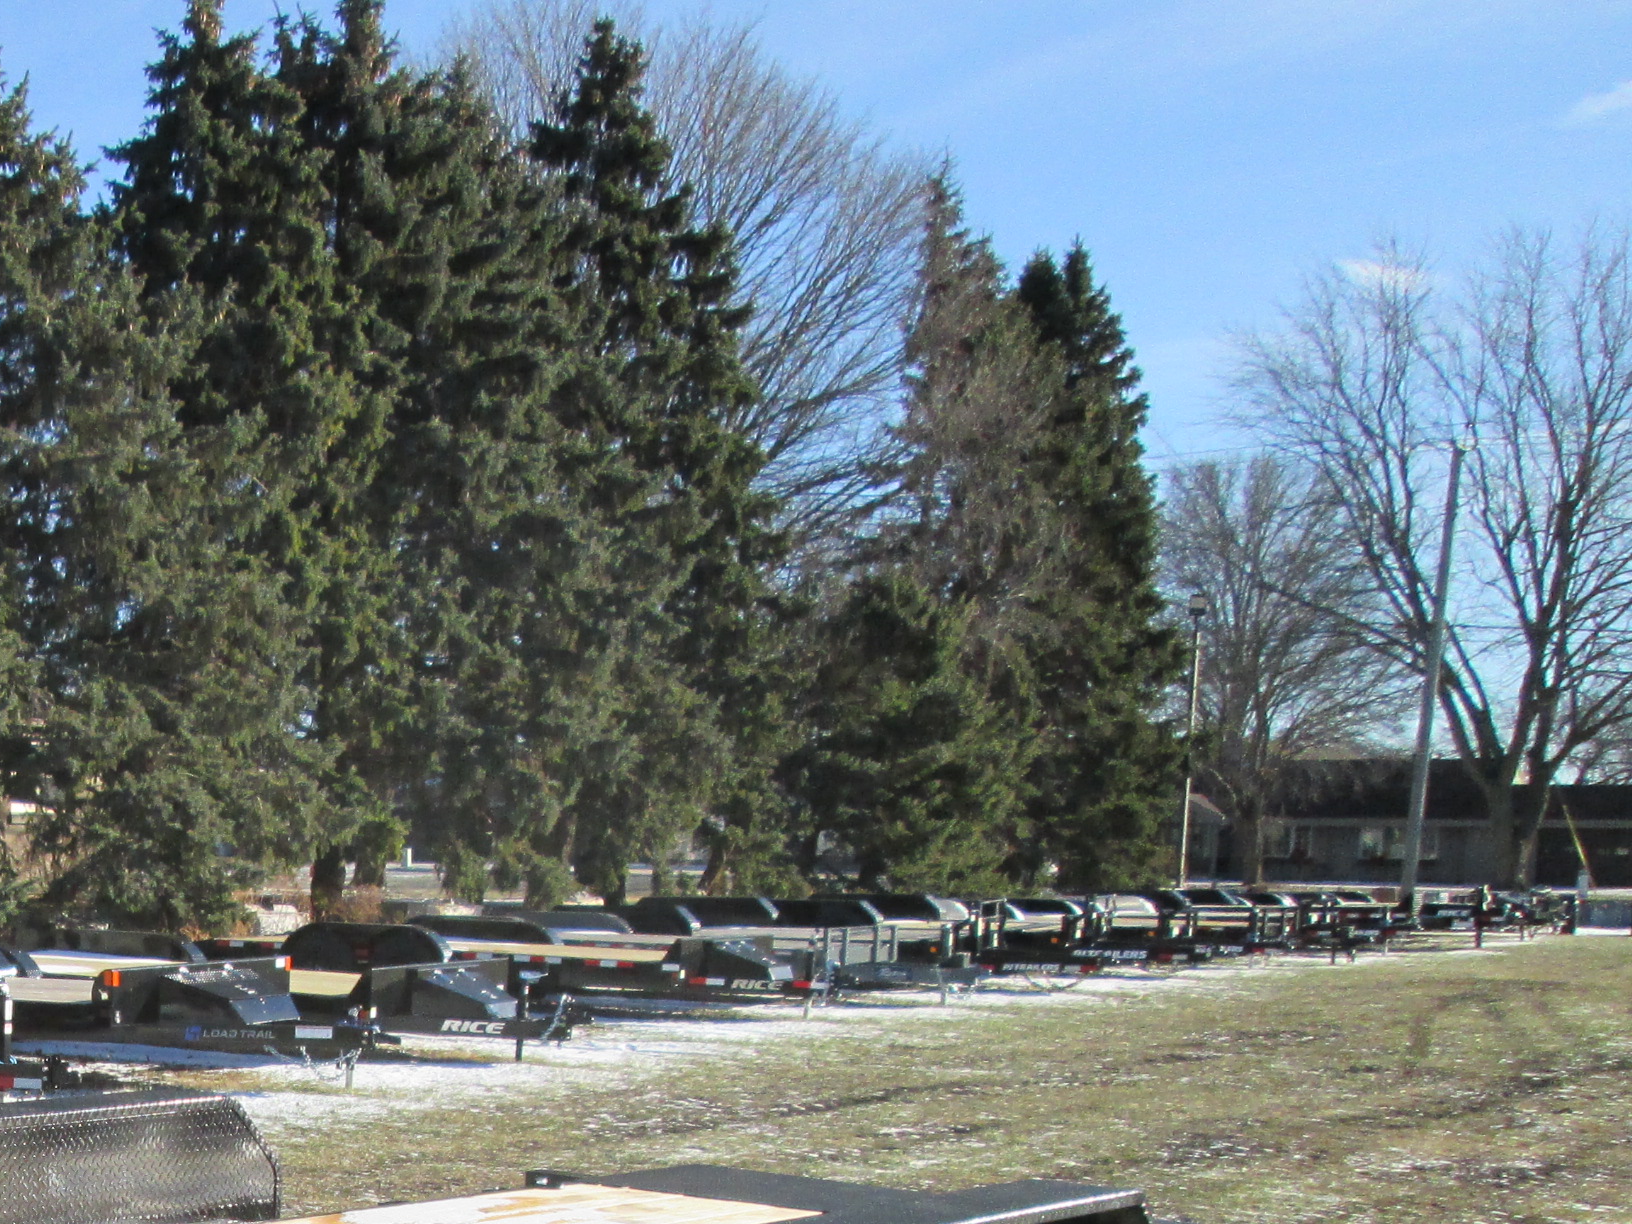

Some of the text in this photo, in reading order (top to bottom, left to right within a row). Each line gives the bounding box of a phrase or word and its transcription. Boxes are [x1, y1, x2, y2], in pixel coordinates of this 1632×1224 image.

[731, 978, 784, 990] RICE
[440, 1019, 506, 1034] RICE
[202, 1029, 276, 1039] LOAD TRAIL
